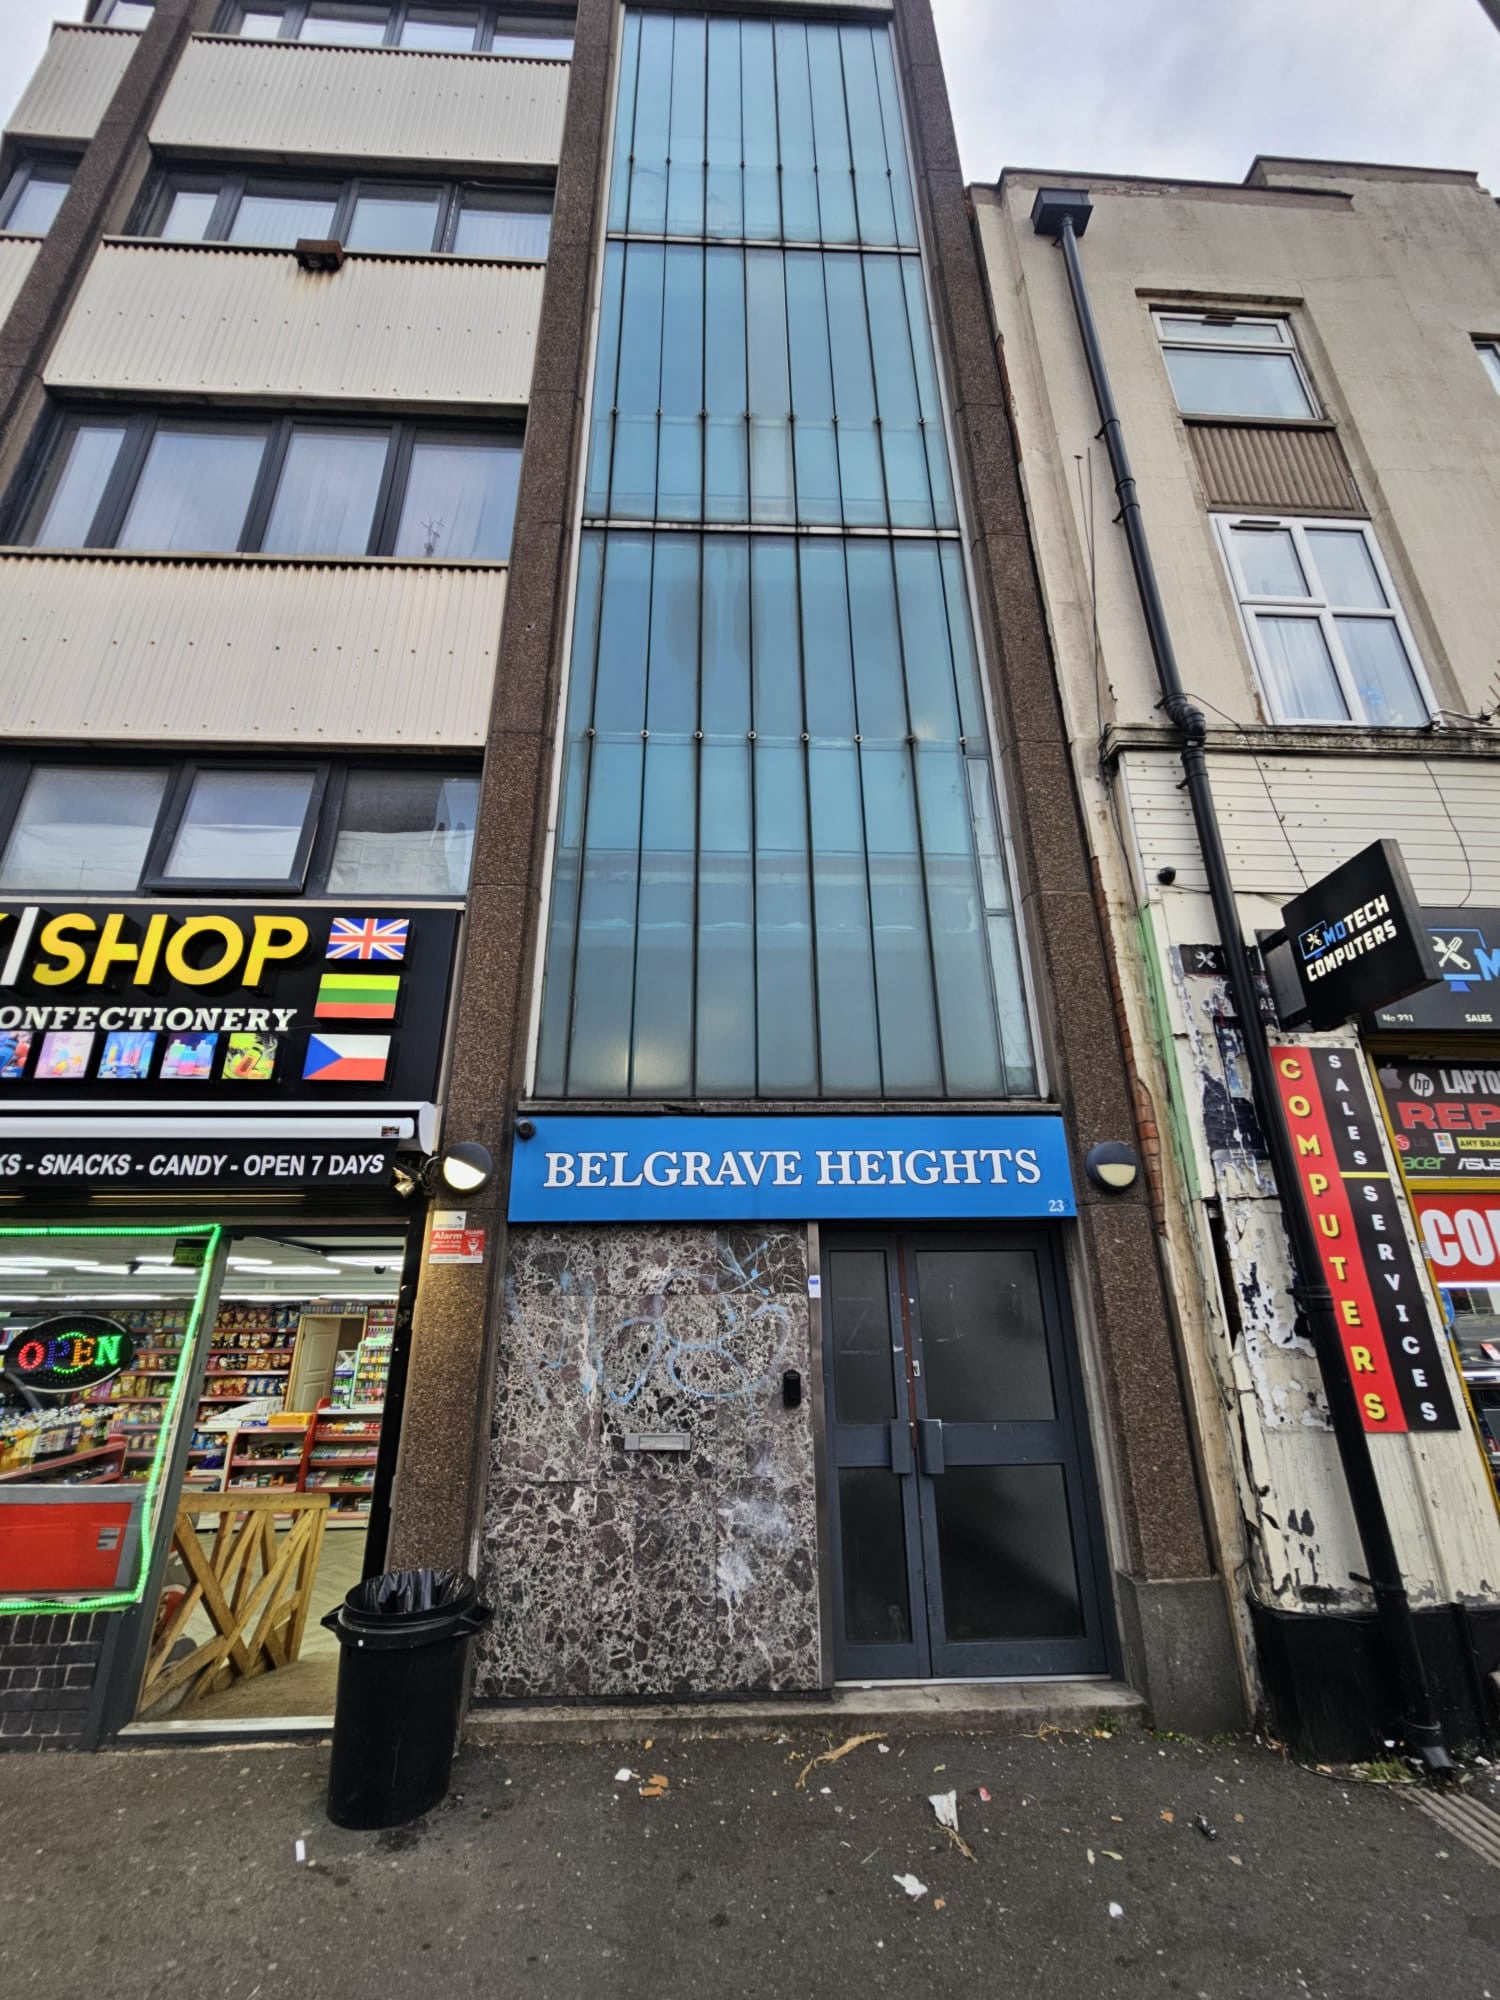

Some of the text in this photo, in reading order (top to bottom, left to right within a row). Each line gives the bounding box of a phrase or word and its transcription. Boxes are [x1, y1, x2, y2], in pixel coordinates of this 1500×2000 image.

[1322, 894, 1390, 947] MOTECH
[32, 912, 309, 986] SHOP
[1306, 918, 1397, 982] COMPUTERS
[1464, 1013, 1493, 1023] SALES
[1438, 1069, 1500, 1094] LAPTO
[38, 1153, 132, 1176] SNACKS
[148, 1154, 228, 1176] CANDY
[243, 1154, 306, 1176] OPEN
[311, 1155, 324, 1176] 7
[328, 1153, 385, 1176] DAYS
[543, 1148, 1042, 1188] BELGRAVE HEIGHTS
[1402, 1156, 1446, 1170] acer
[433, 1231, 463, 1240] Alarm
[1280, 1058, 1387, 1421] COMPUTERS
[1328, 1054, 1439, 1422] SALES SERVICES
[18, 1334, 123, 1371] OPEN
